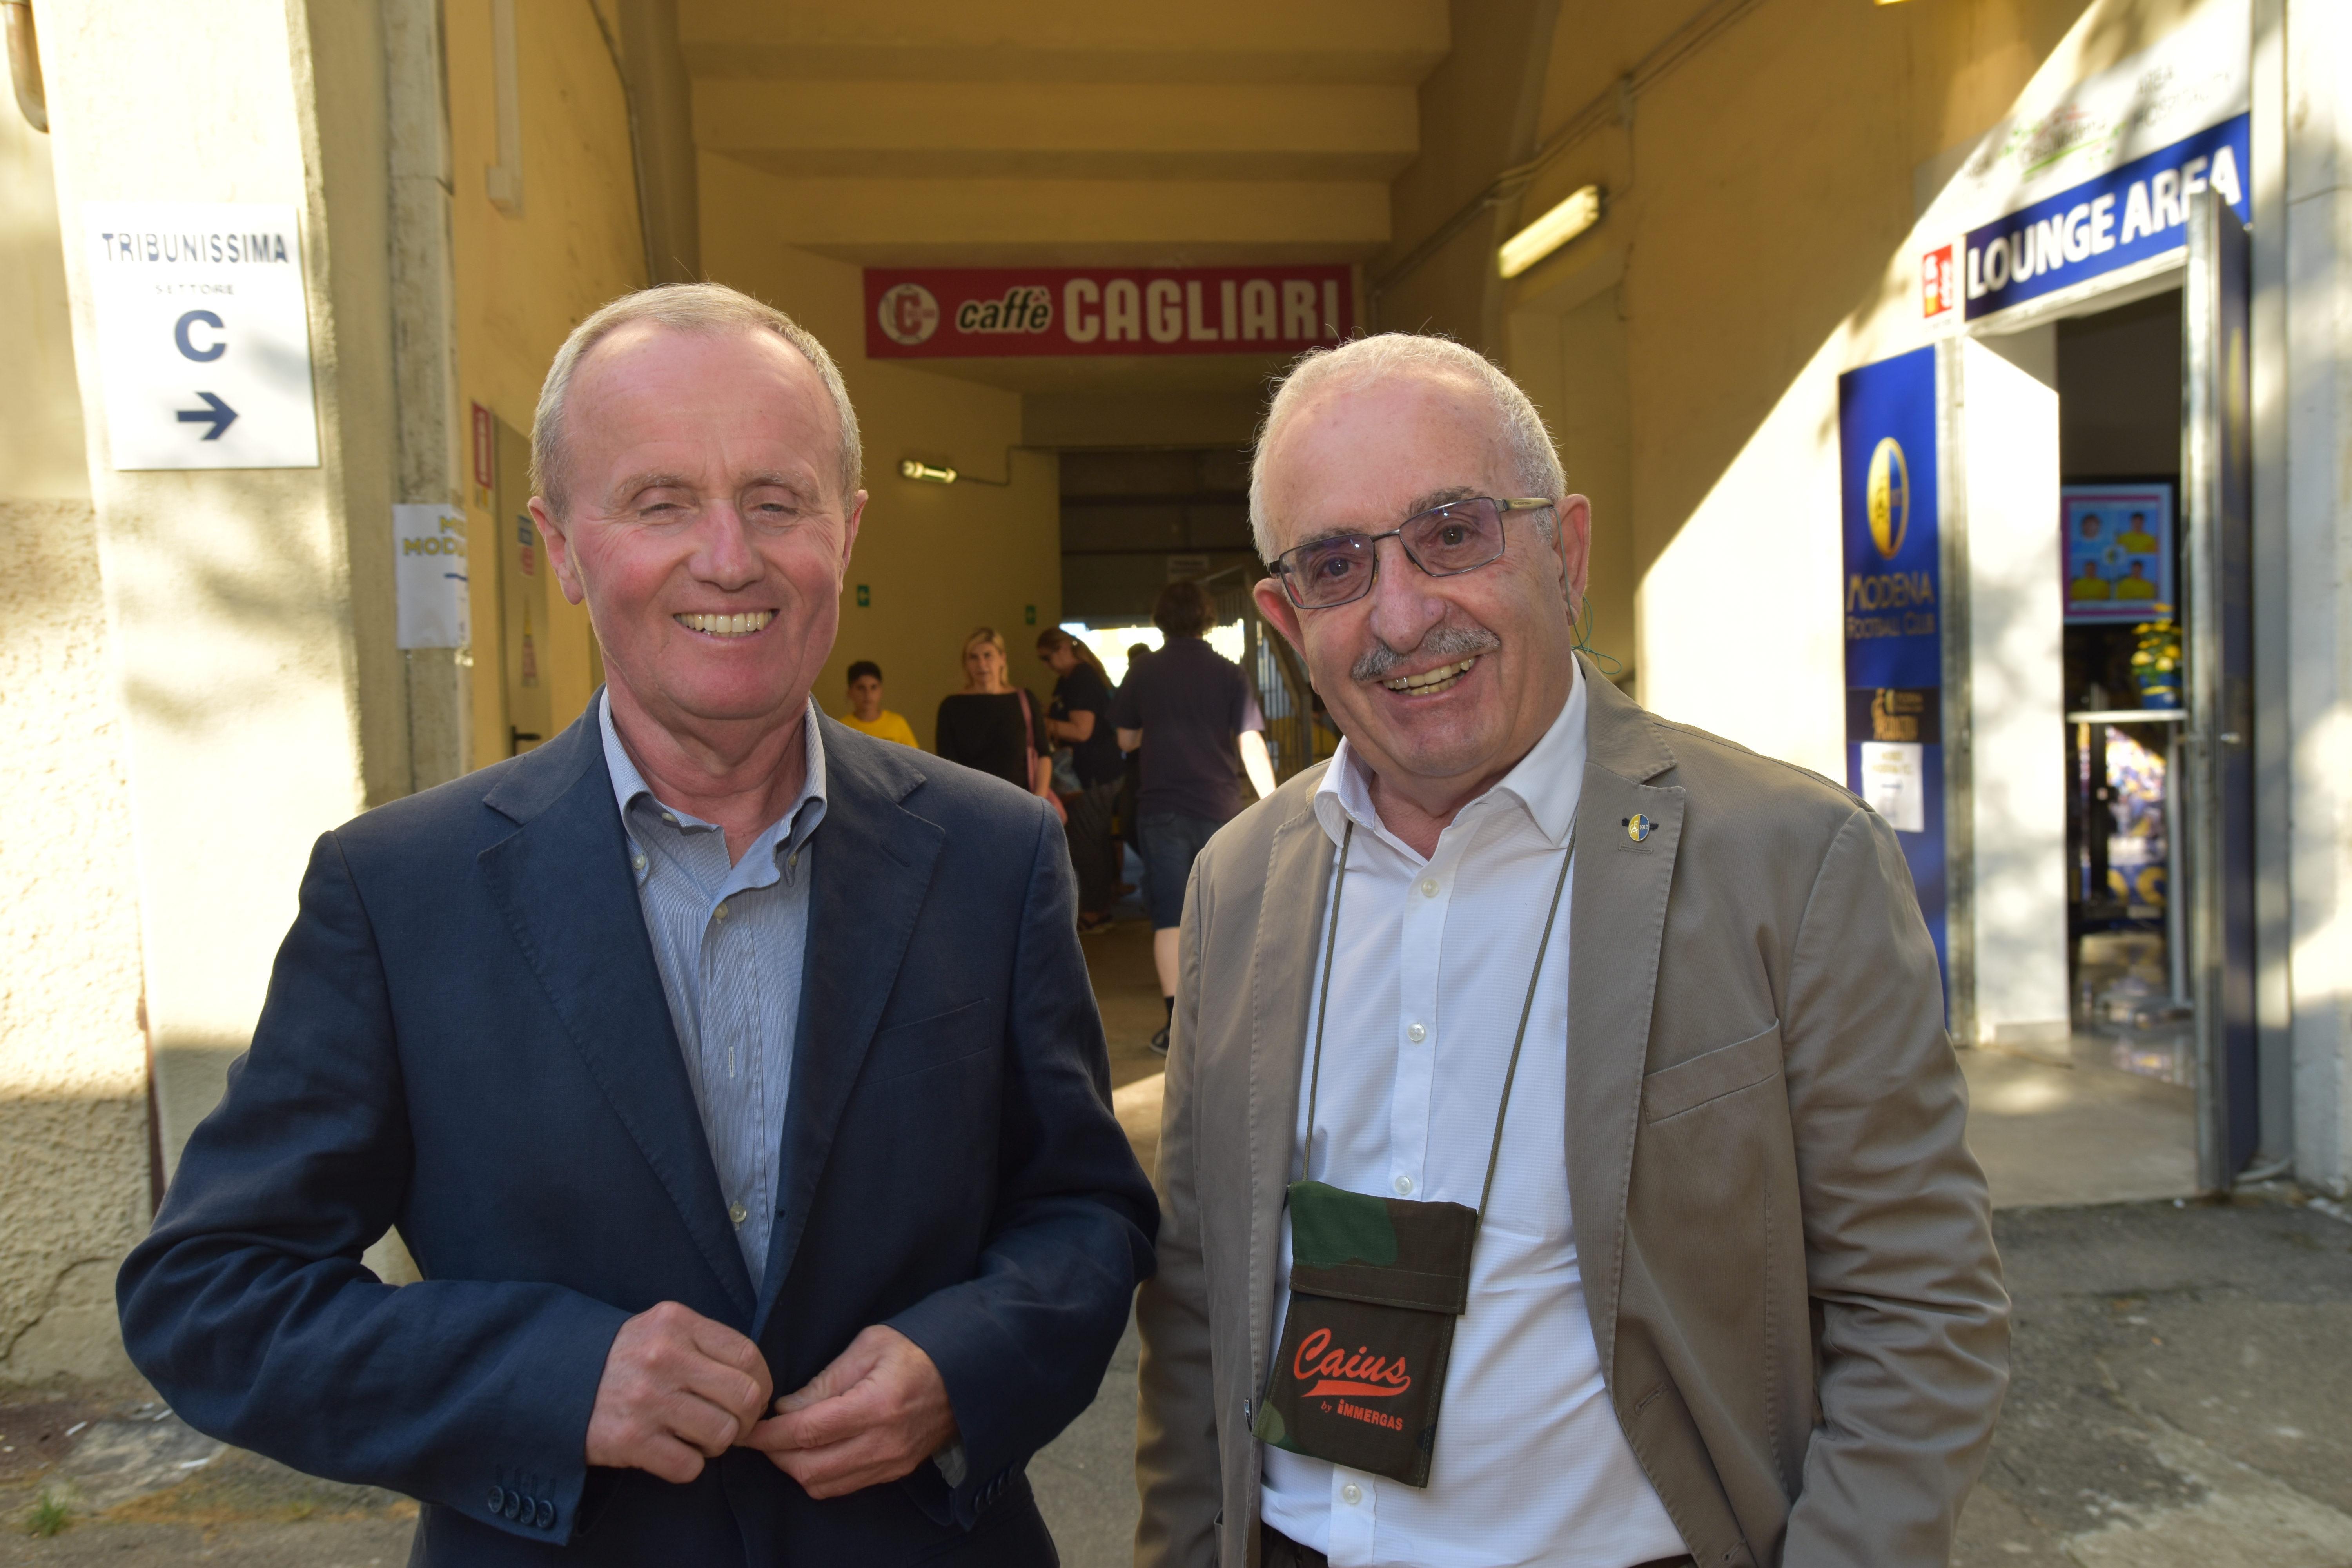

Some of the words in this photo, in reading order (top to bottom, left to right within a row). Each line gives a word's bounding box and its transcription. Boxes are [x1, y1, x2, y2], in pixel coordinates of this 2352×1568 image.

[102, 233, 290, 263] TRIBUNISSIMA
[1967, 193, 2115, 300] LOUNGE
[2120, 145, 2242, 245] AREA
[155, 284, 235, 295] SETTORE
[959, 289, 1050, 330] caffè
[1063, 278, 1339, 343] CAGLIARI
[174, 309, 227, 362] C
[1294, 1327, 1411, 1385] Caius
[1321, 1401, 1332, 1413] by
